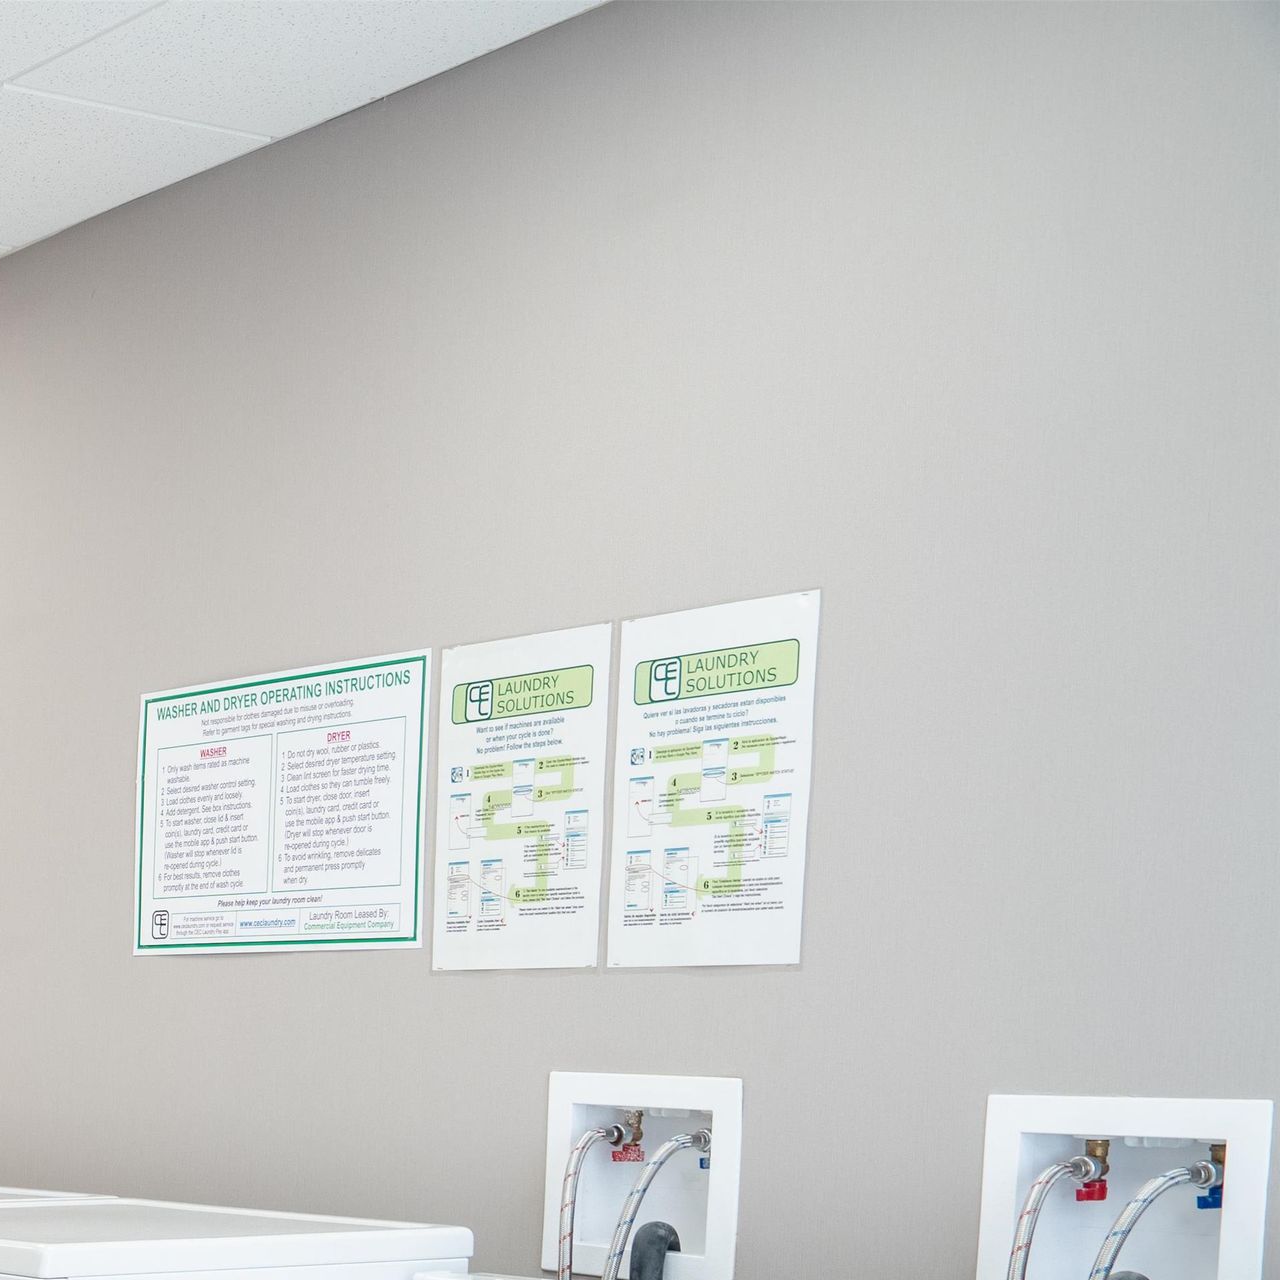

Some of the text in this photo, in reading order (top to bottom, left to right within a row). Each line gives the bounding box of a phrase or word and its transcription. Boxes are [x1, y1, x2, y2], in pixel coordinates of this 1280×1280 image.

[687, 650, 758, 673] LAUNDRY
[498, 675, 558, 696] LAUNDRY
[686, 667, 776, 692] SOLUTIONS
[156, 669, 410, 720] WASHER AND DRYER OPERATING INSTRUCTIONS
[496, 690, 574, 713] SOLUTIONS
[327, 730, 351, 741] DRYER
[200, 746, 227, 757] WASHER
[217, 899, 233, 907] Please
[246, 898, 258, 906] keep
[258, 898, 271, 906] your
[271, 896, 291, 905] laundry
[306, 894, 322, 902] clean!
[309, 911, 333, 921] Laundry
[334, 910, 353, 919] Room
[354, 909, 377, 918] Leased
[239, 918, 295, 928] www.ceclaundry.com
[303, 920, 394, 930] Commercial Equipment Company
